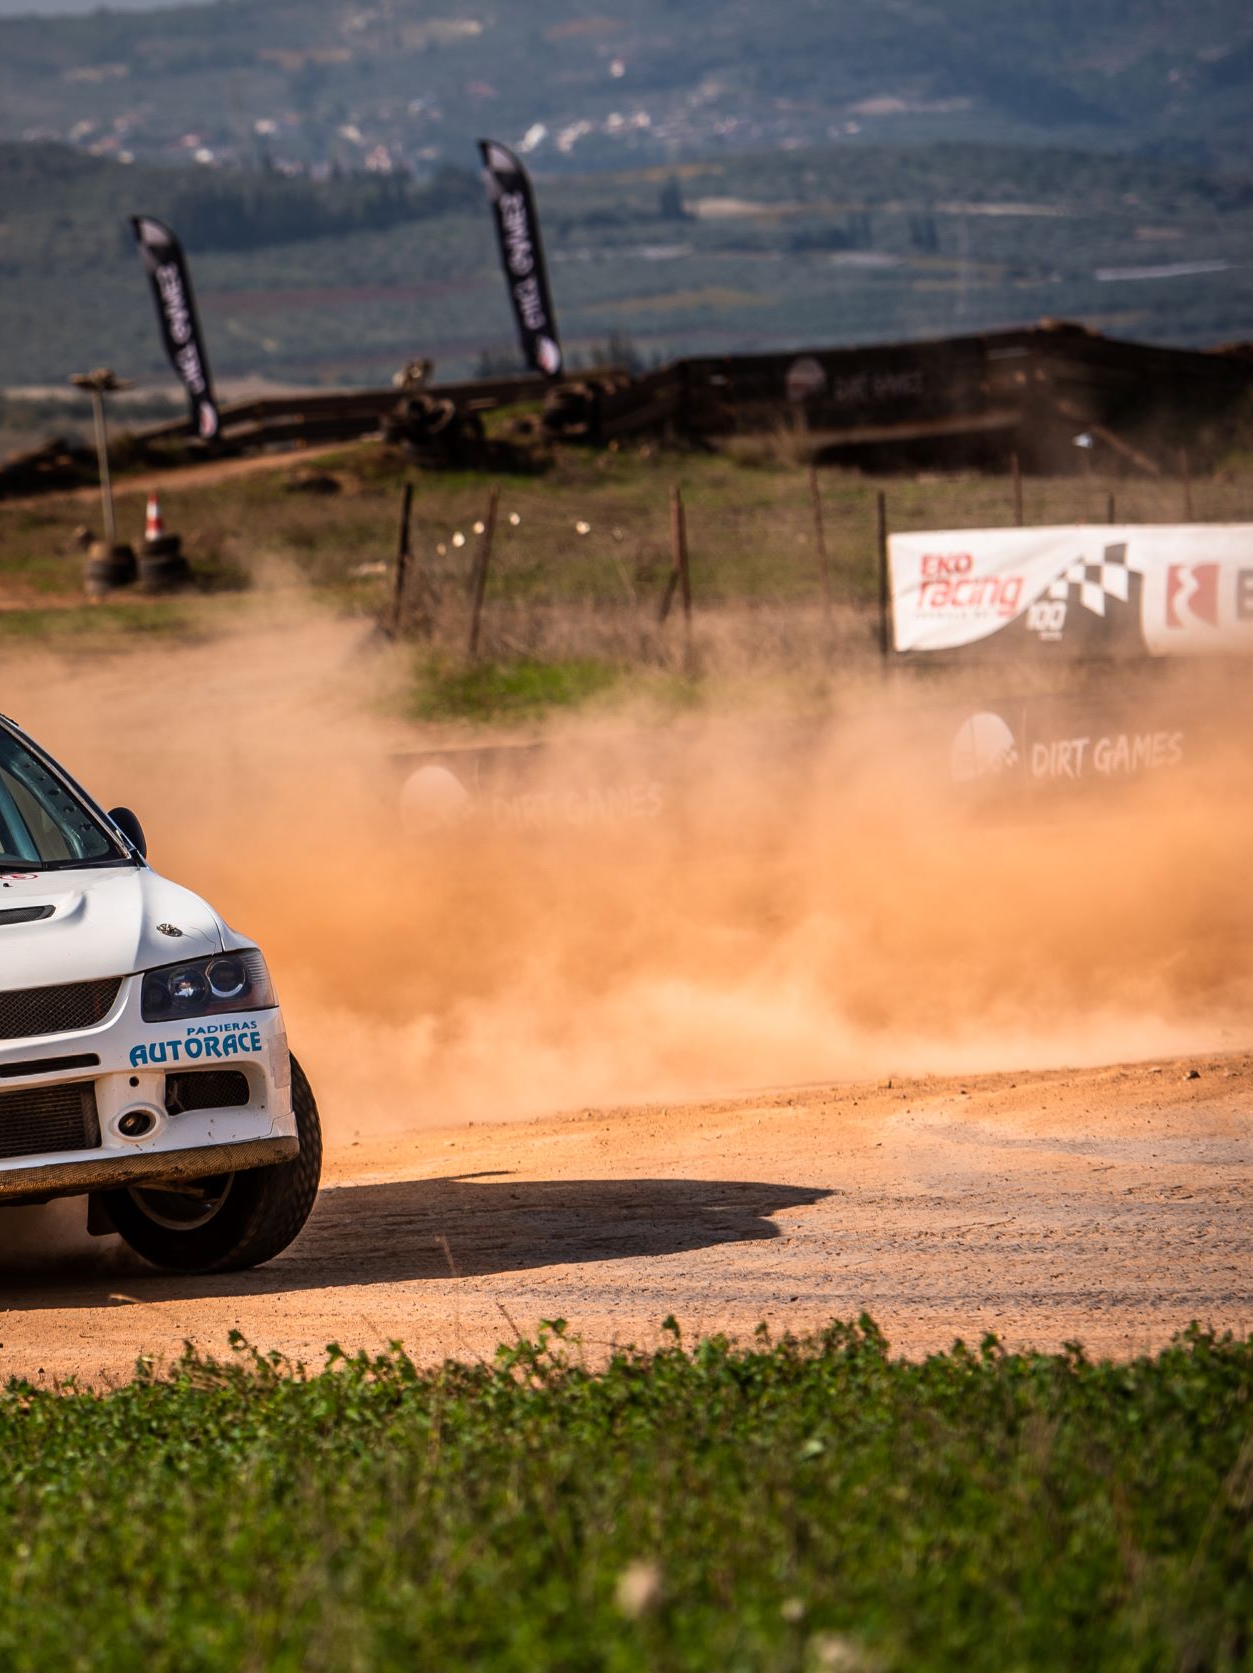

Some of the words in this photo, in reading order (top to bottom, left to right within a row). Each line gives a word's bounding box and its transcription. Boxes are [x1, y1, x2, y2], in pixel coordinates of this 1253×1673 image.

[918, 576, 1024, 618] racing
[1027, 600, 1068, 631] 100
[1032, 737, 1090, 780] DIRT
[1094, 731, 1185, 776] GAMES
[187, 1020, 257, 1036] PADIERAS
[129, 1031, 262, 1068] AUTORACE
